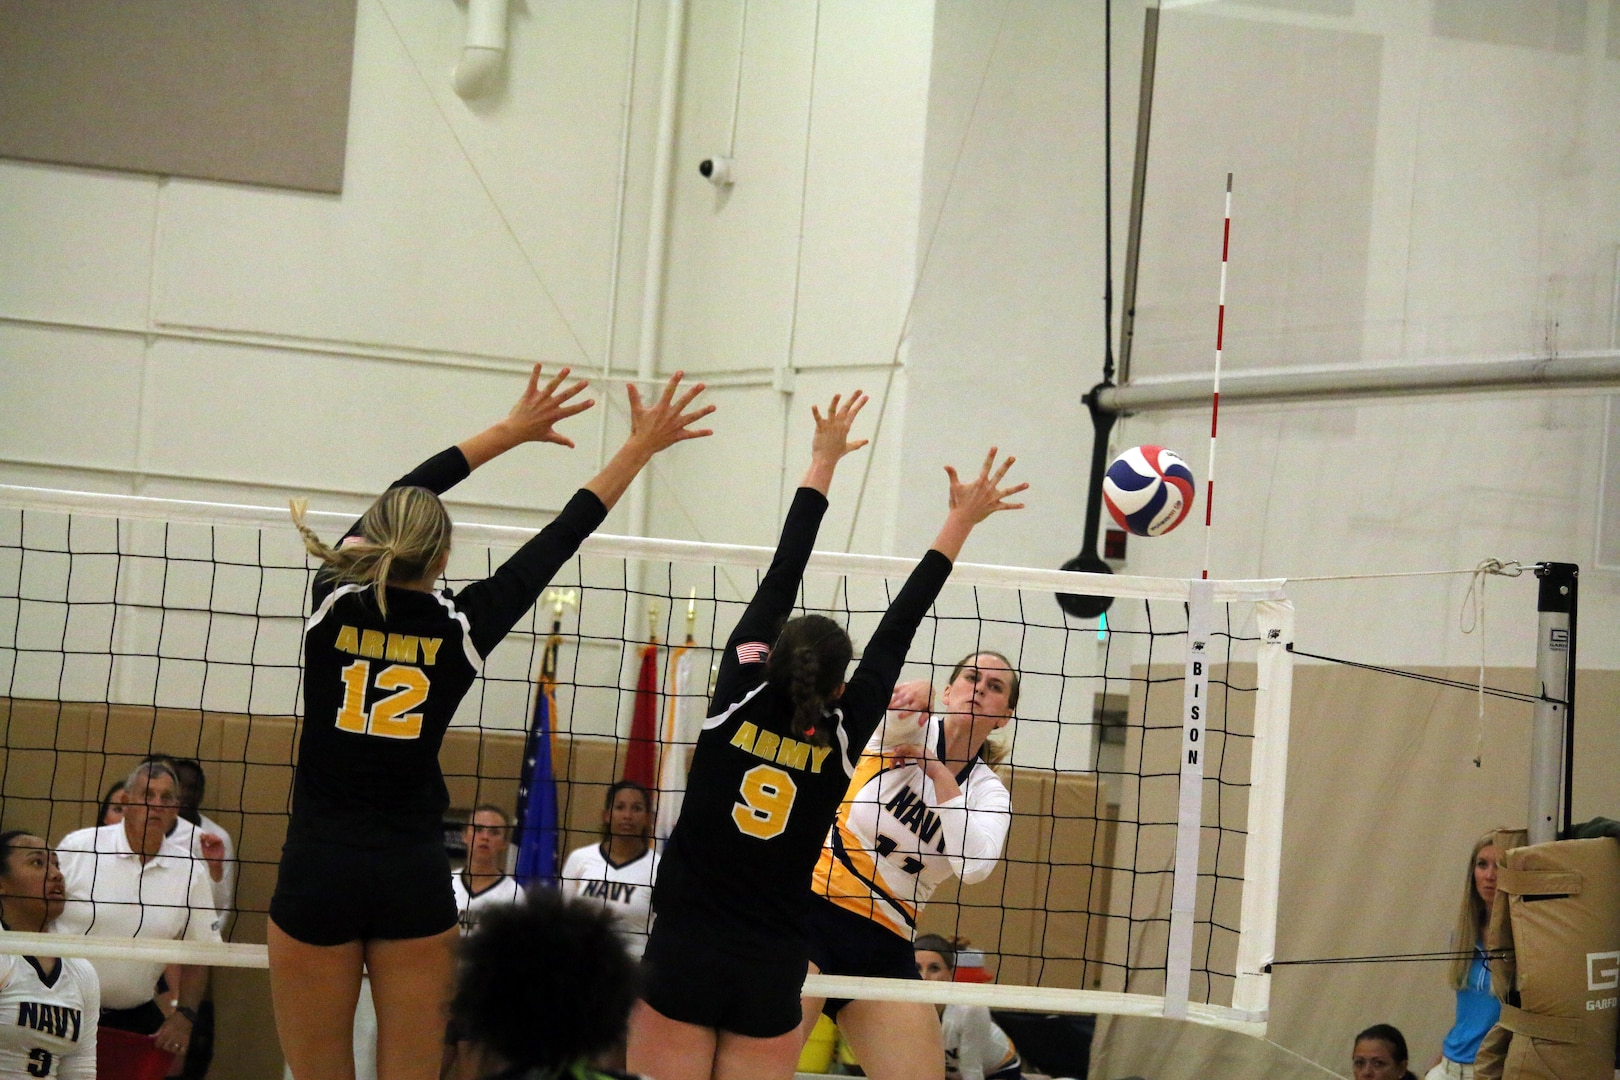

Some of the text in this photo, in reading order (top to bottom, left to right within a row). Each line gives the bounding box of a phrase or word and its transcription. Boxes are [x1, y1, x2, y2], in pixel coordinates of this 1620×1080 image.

[334, 625, 444, 666] ARMY
[335, 659, 431, 740] 12
[1188, 661, 1203, 765] BISON
[729, 720, 833, 774] ARMY
[731, 763, 798, 841] 9
[583, 880, 636, 905] NAVY
[17, 1001, 82, 1043] NAVY
[27, 1047, 53, 1079] 3
